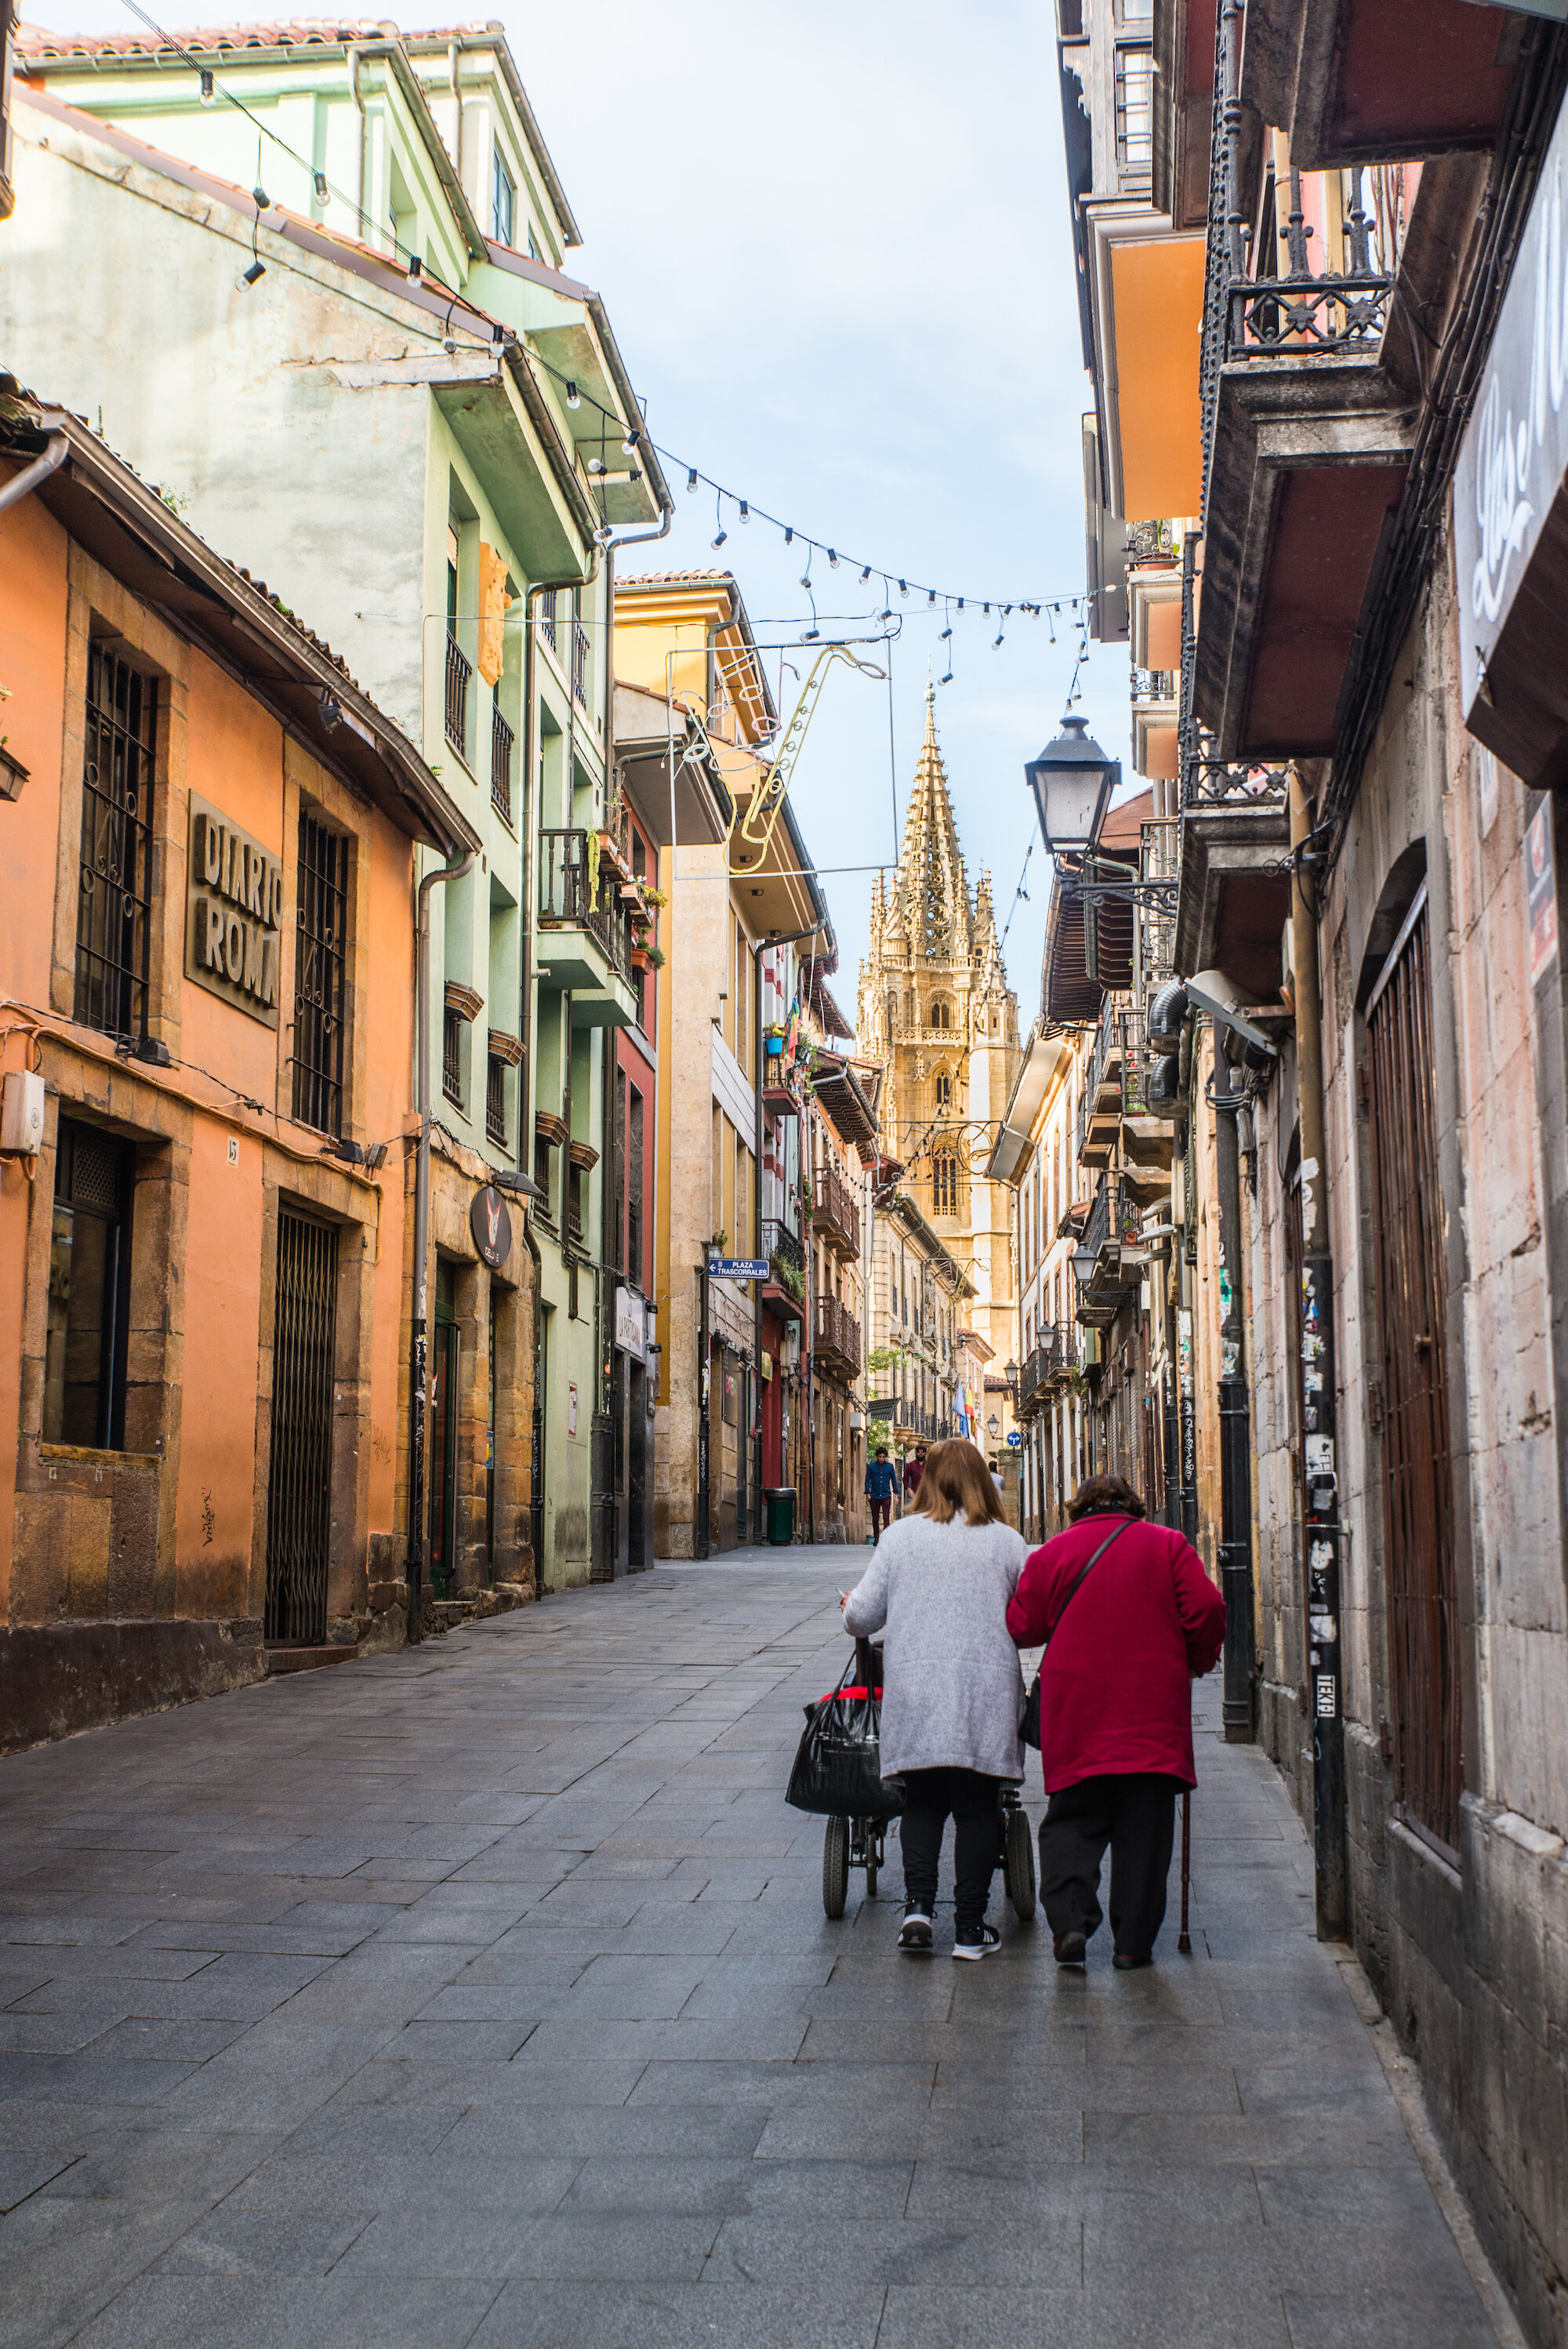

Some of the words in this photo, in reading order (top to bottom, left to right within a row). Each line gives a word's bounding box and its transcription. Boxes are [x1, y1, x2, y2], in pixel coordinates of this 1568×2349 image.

[196, 812, 284, 931] DIARIO
[197, 897, 279, 1010] ROMA
[717, 1268, 768, 1276] TRASCORRALES
